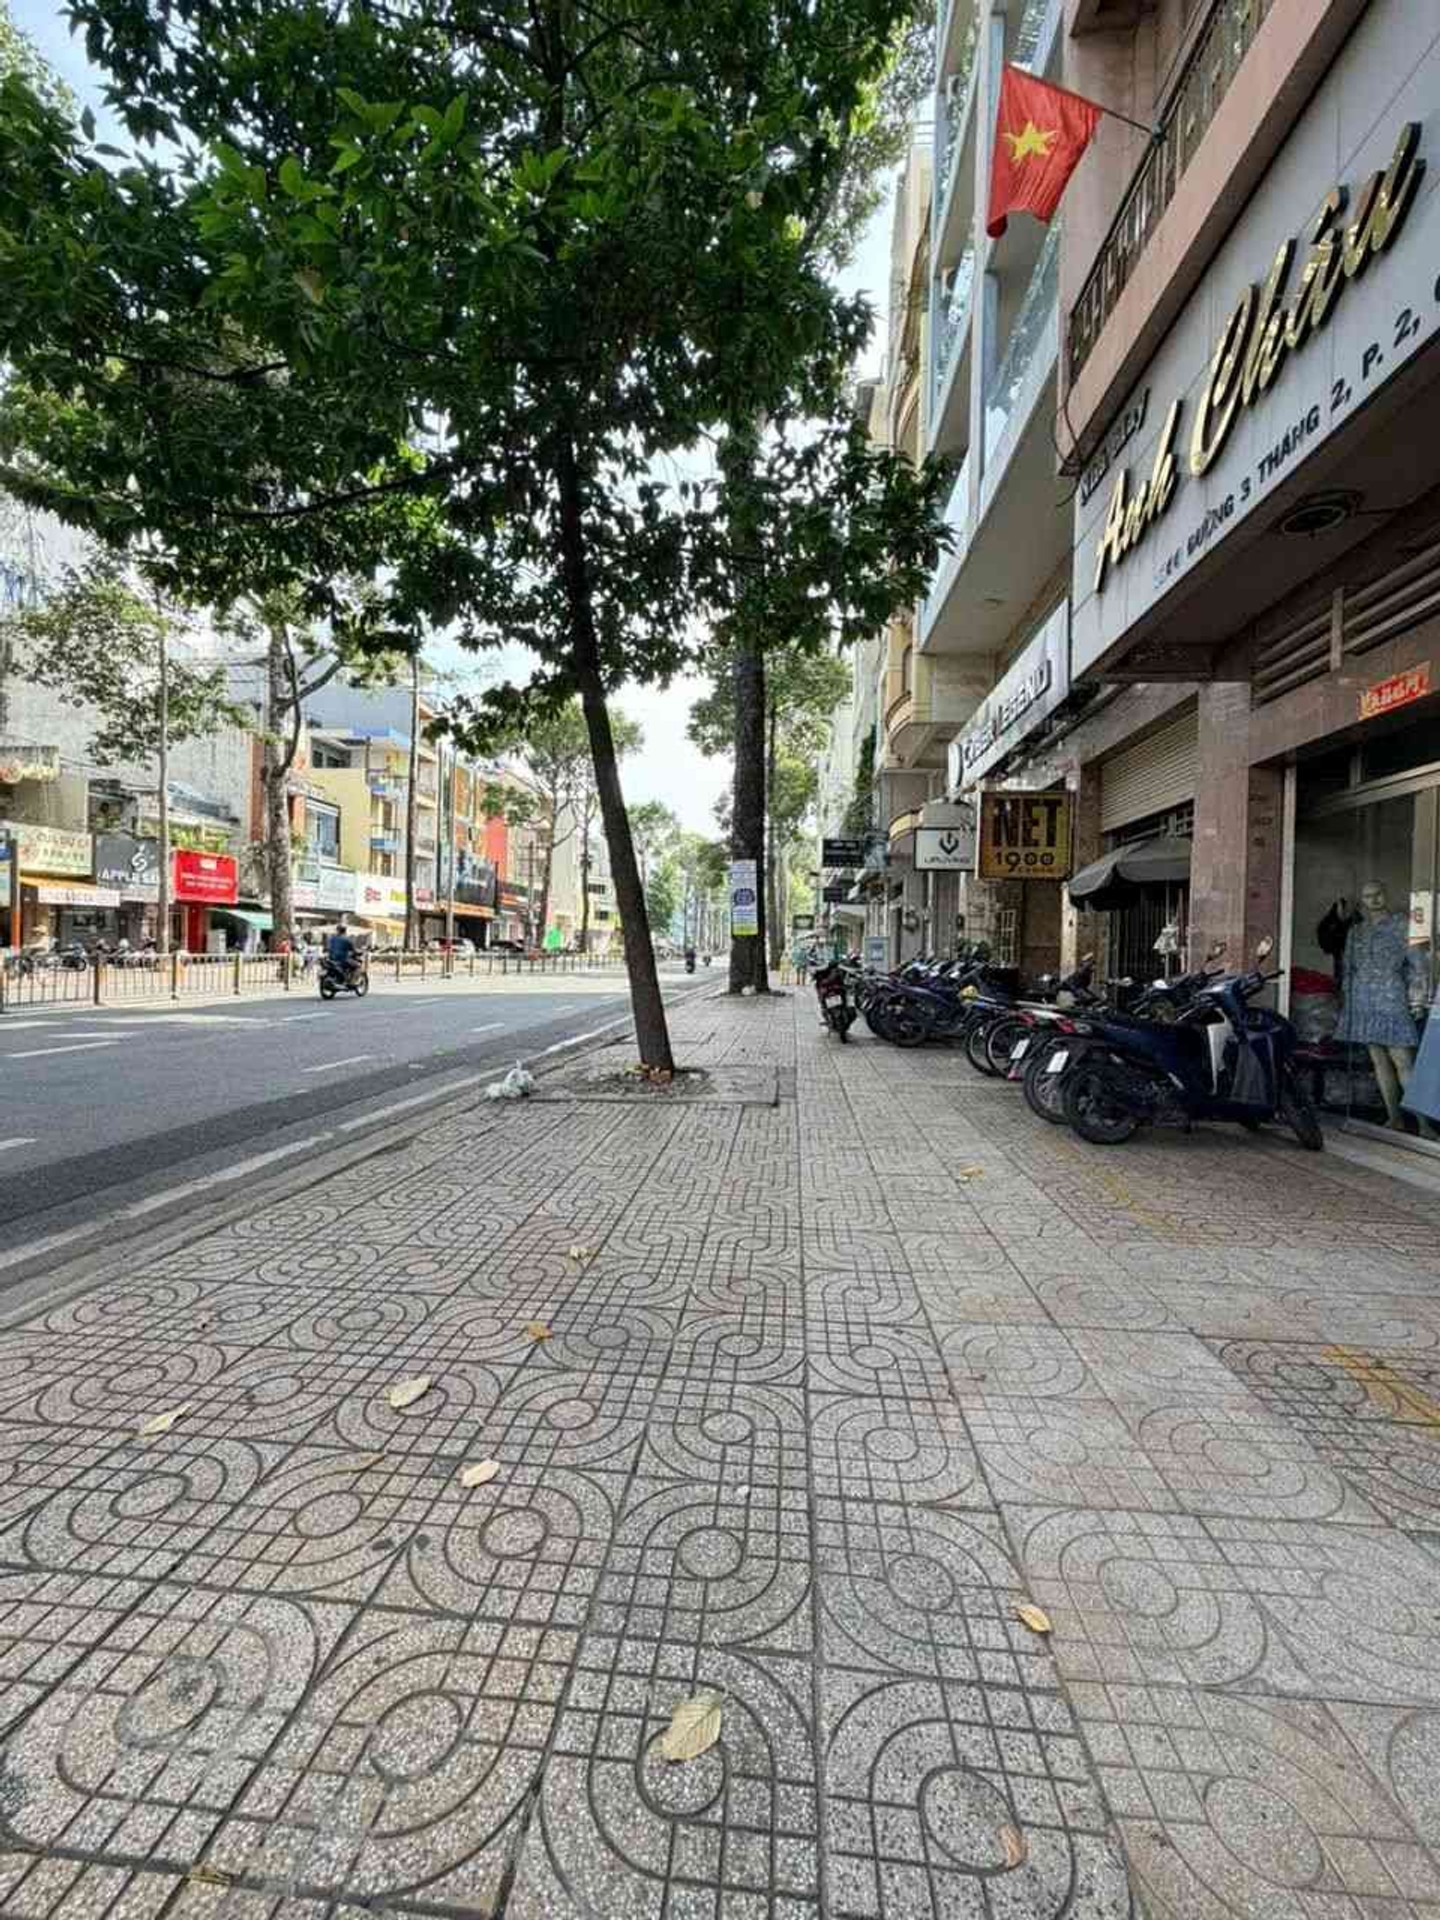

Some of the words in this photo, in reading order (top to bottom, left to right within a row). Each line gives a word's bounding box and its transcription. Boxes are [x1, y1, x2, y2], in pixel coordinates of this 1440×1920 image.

[1094, 398, 1182, 592] Anh
[1190, 121, 1426, 477] Châu
[1330, 377, 1352, 413] 2,
[1361, 342, 1384, 381] P.
[1393, 307, 1421, 348] 2,
[991, 799, 1062, 847] NET
